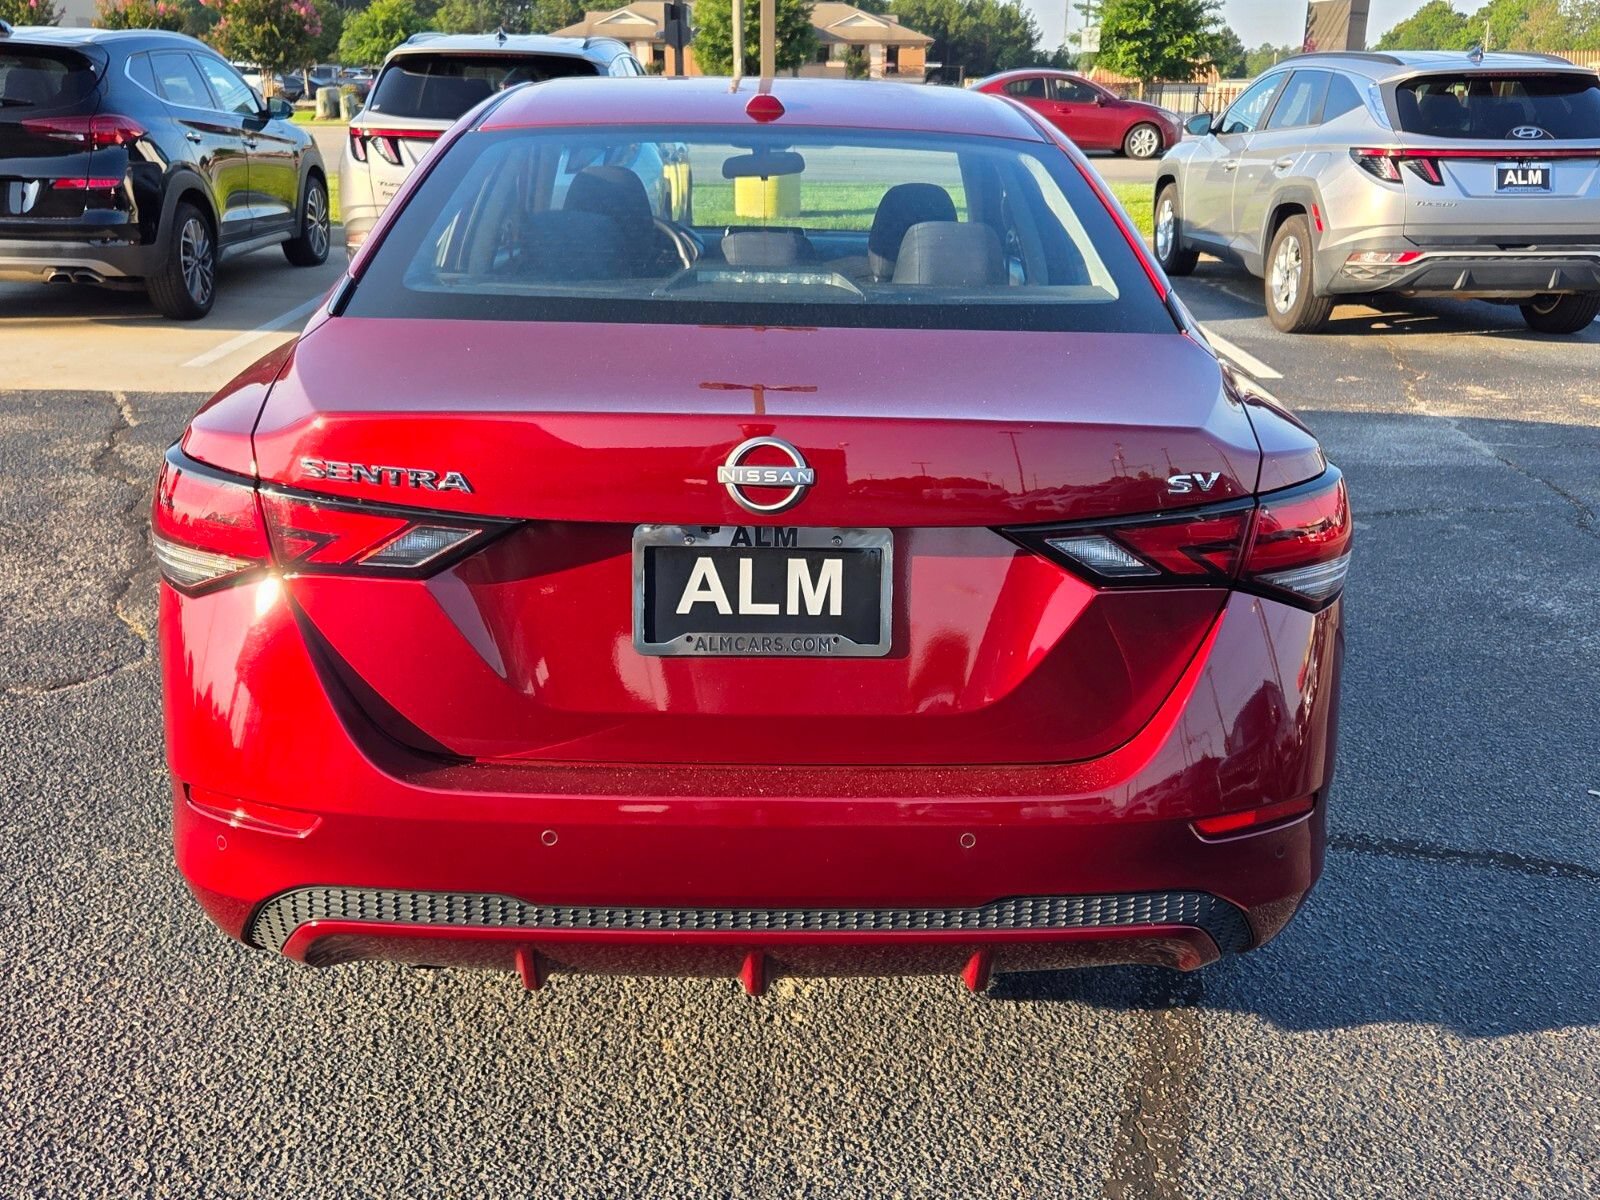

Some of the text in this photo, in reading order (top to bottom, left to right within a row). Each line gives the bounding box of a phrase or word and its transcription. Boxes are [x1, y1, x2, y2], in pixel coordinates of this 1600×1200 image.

[1504, 169, 1542, 185] ALM
[300, 457, 474, 494] SENTRA
[720, 468, 812, 483] NISSAN
[1167, 471, 1221, 495] SV
[730, 526, 798, 547] ALM
[676, 556, 843, 616] ALM
[693, 636, 832, 653] ALMCARS.COM
